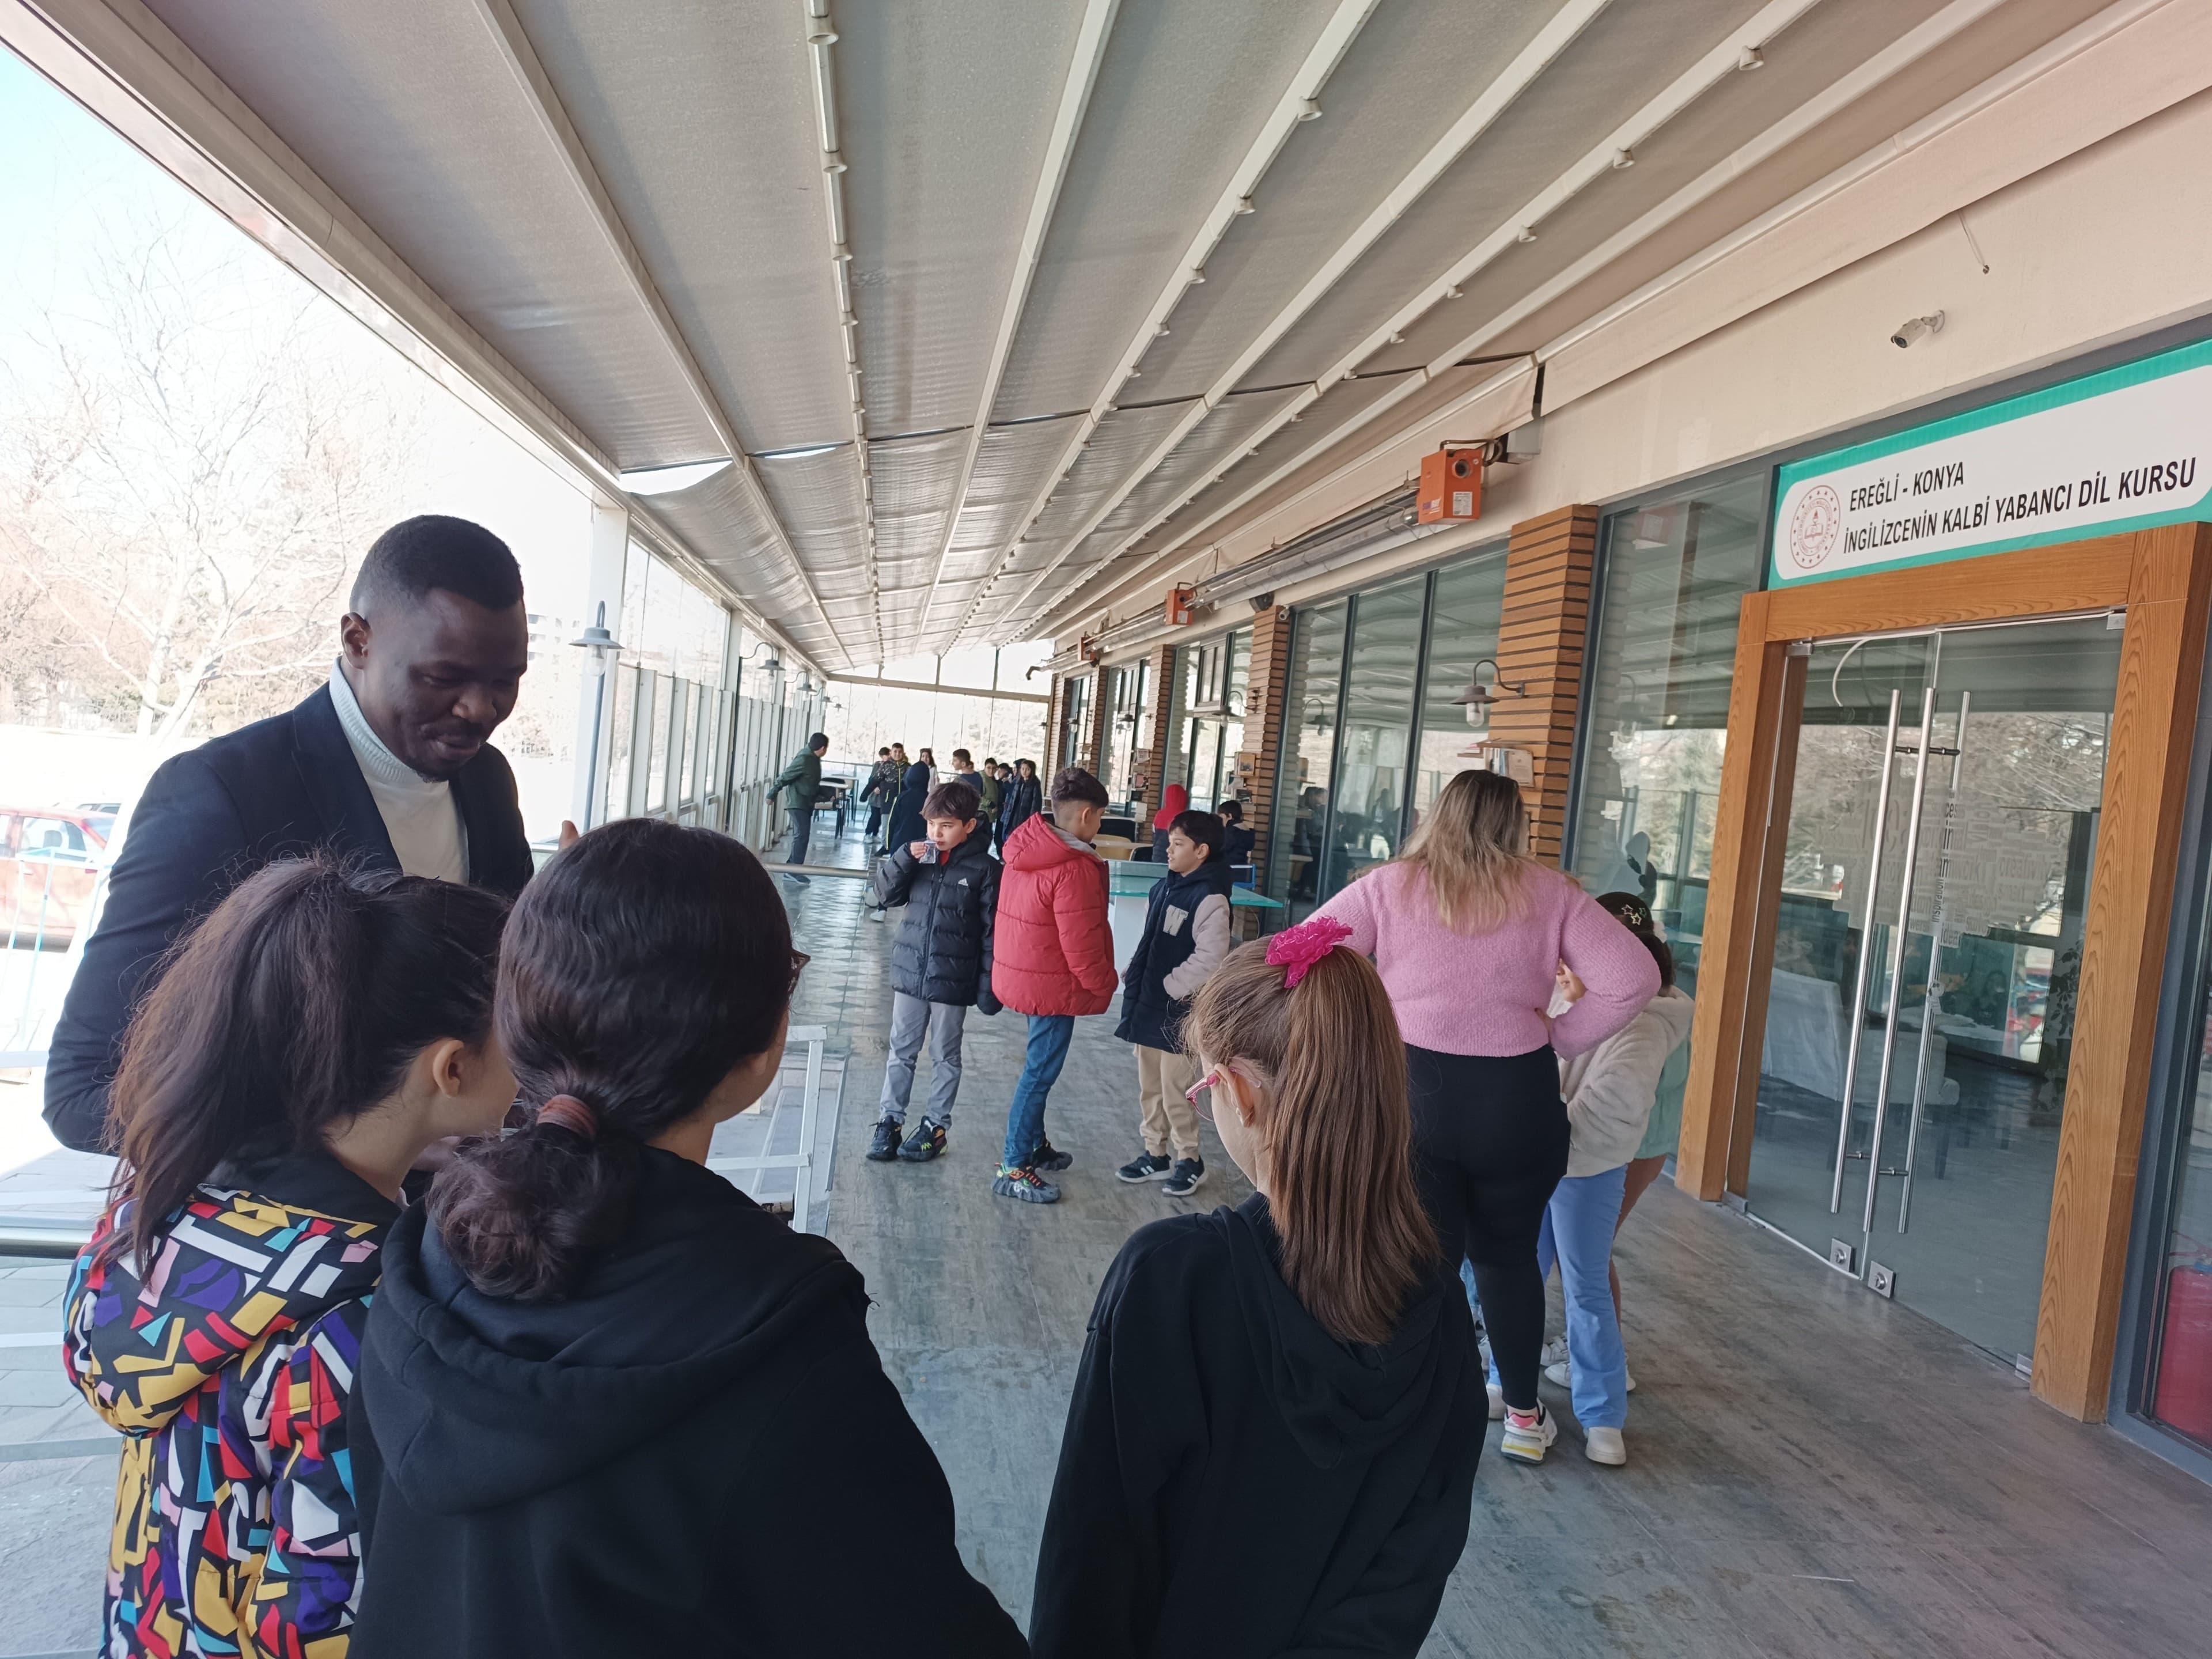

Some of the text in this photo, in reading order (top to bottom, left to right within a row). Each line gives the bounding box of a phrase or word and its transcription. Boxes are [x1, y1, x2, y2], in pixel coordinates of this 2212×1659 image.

[1844, 509, 1938, 554] İNGİLİZCENİN
[1942, 495, 1990, 533] KALBİ
[1995, 483, 2073, 523] YABANCI
[2078, 471, 2110, 507] DİL
[2118, 457, 2196, 500] KURSU
[1850, 473, 1899, 512] EREĞLİ
[1912, 461, 1964, 497] KONYA
[1163, 904, 1188, 937] W
